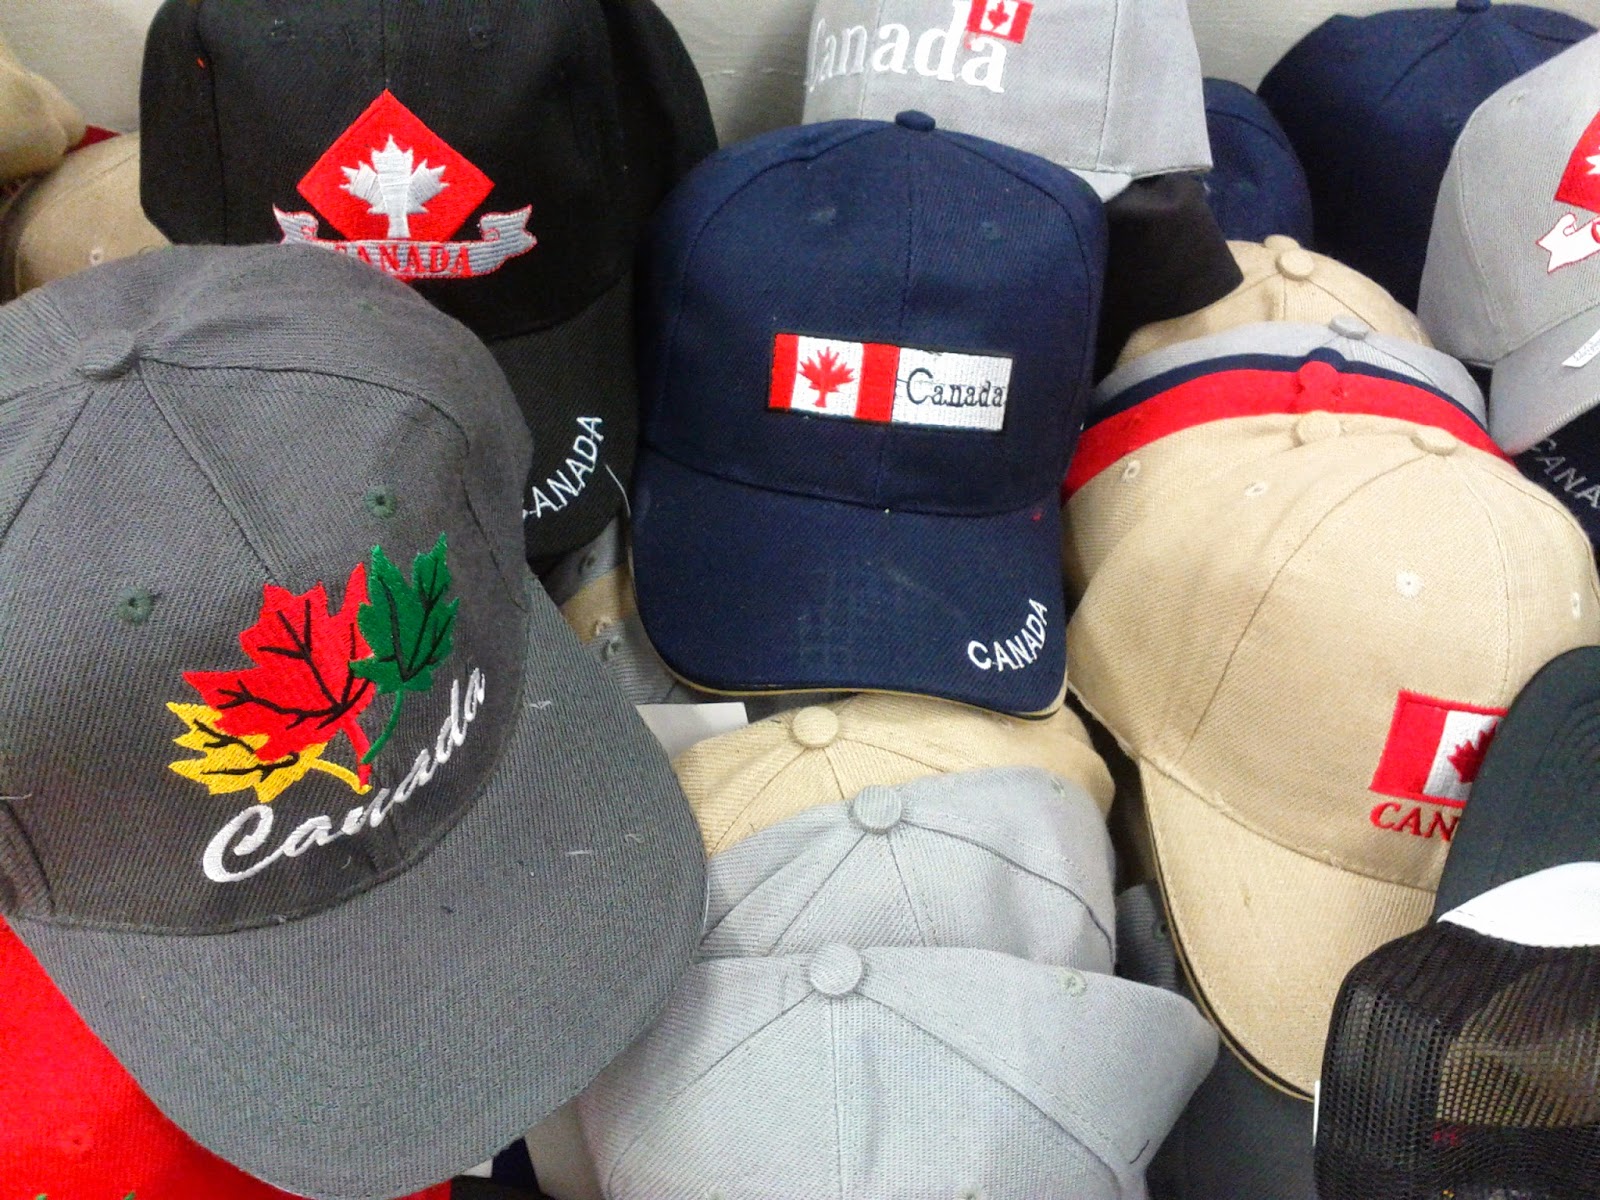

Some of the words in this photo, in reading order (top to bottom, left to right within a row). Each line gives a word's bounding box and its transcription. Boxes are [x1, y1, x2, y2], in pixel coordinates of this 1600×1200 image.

[907, 367, 1003, 408] Canada
[523, 416, 604, 519] ANADA
[967, 598, 1048, 672] CANADA
[202, 667, 486, 883] Canada
